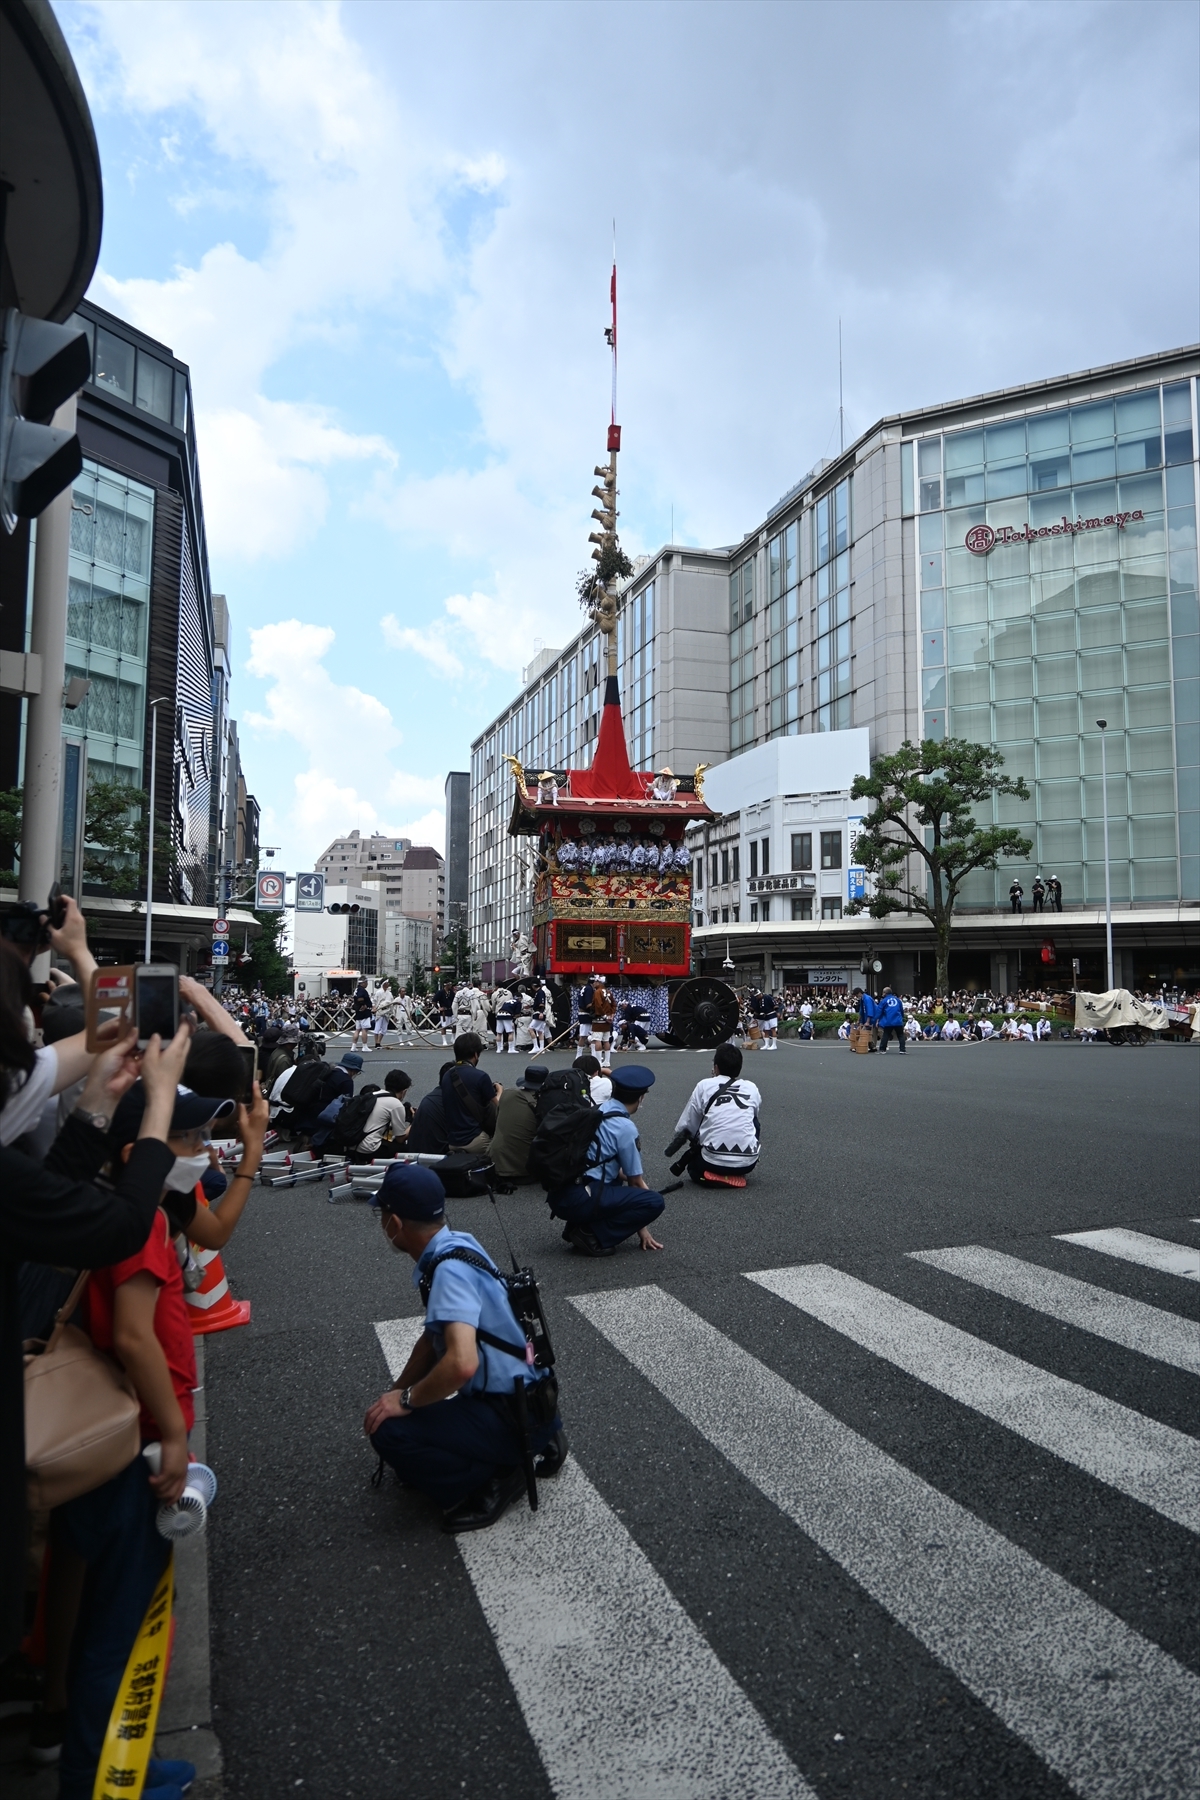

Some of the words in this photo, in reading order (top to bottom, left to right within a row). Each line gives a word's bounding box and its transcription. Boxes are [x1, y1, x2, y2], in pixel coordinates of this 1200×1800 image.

[997, 509, 1144, 544] Takashimaya
[813, 975, 843, 983] コンタクト
[117, 1655, 161, 1741] 京都府警察
